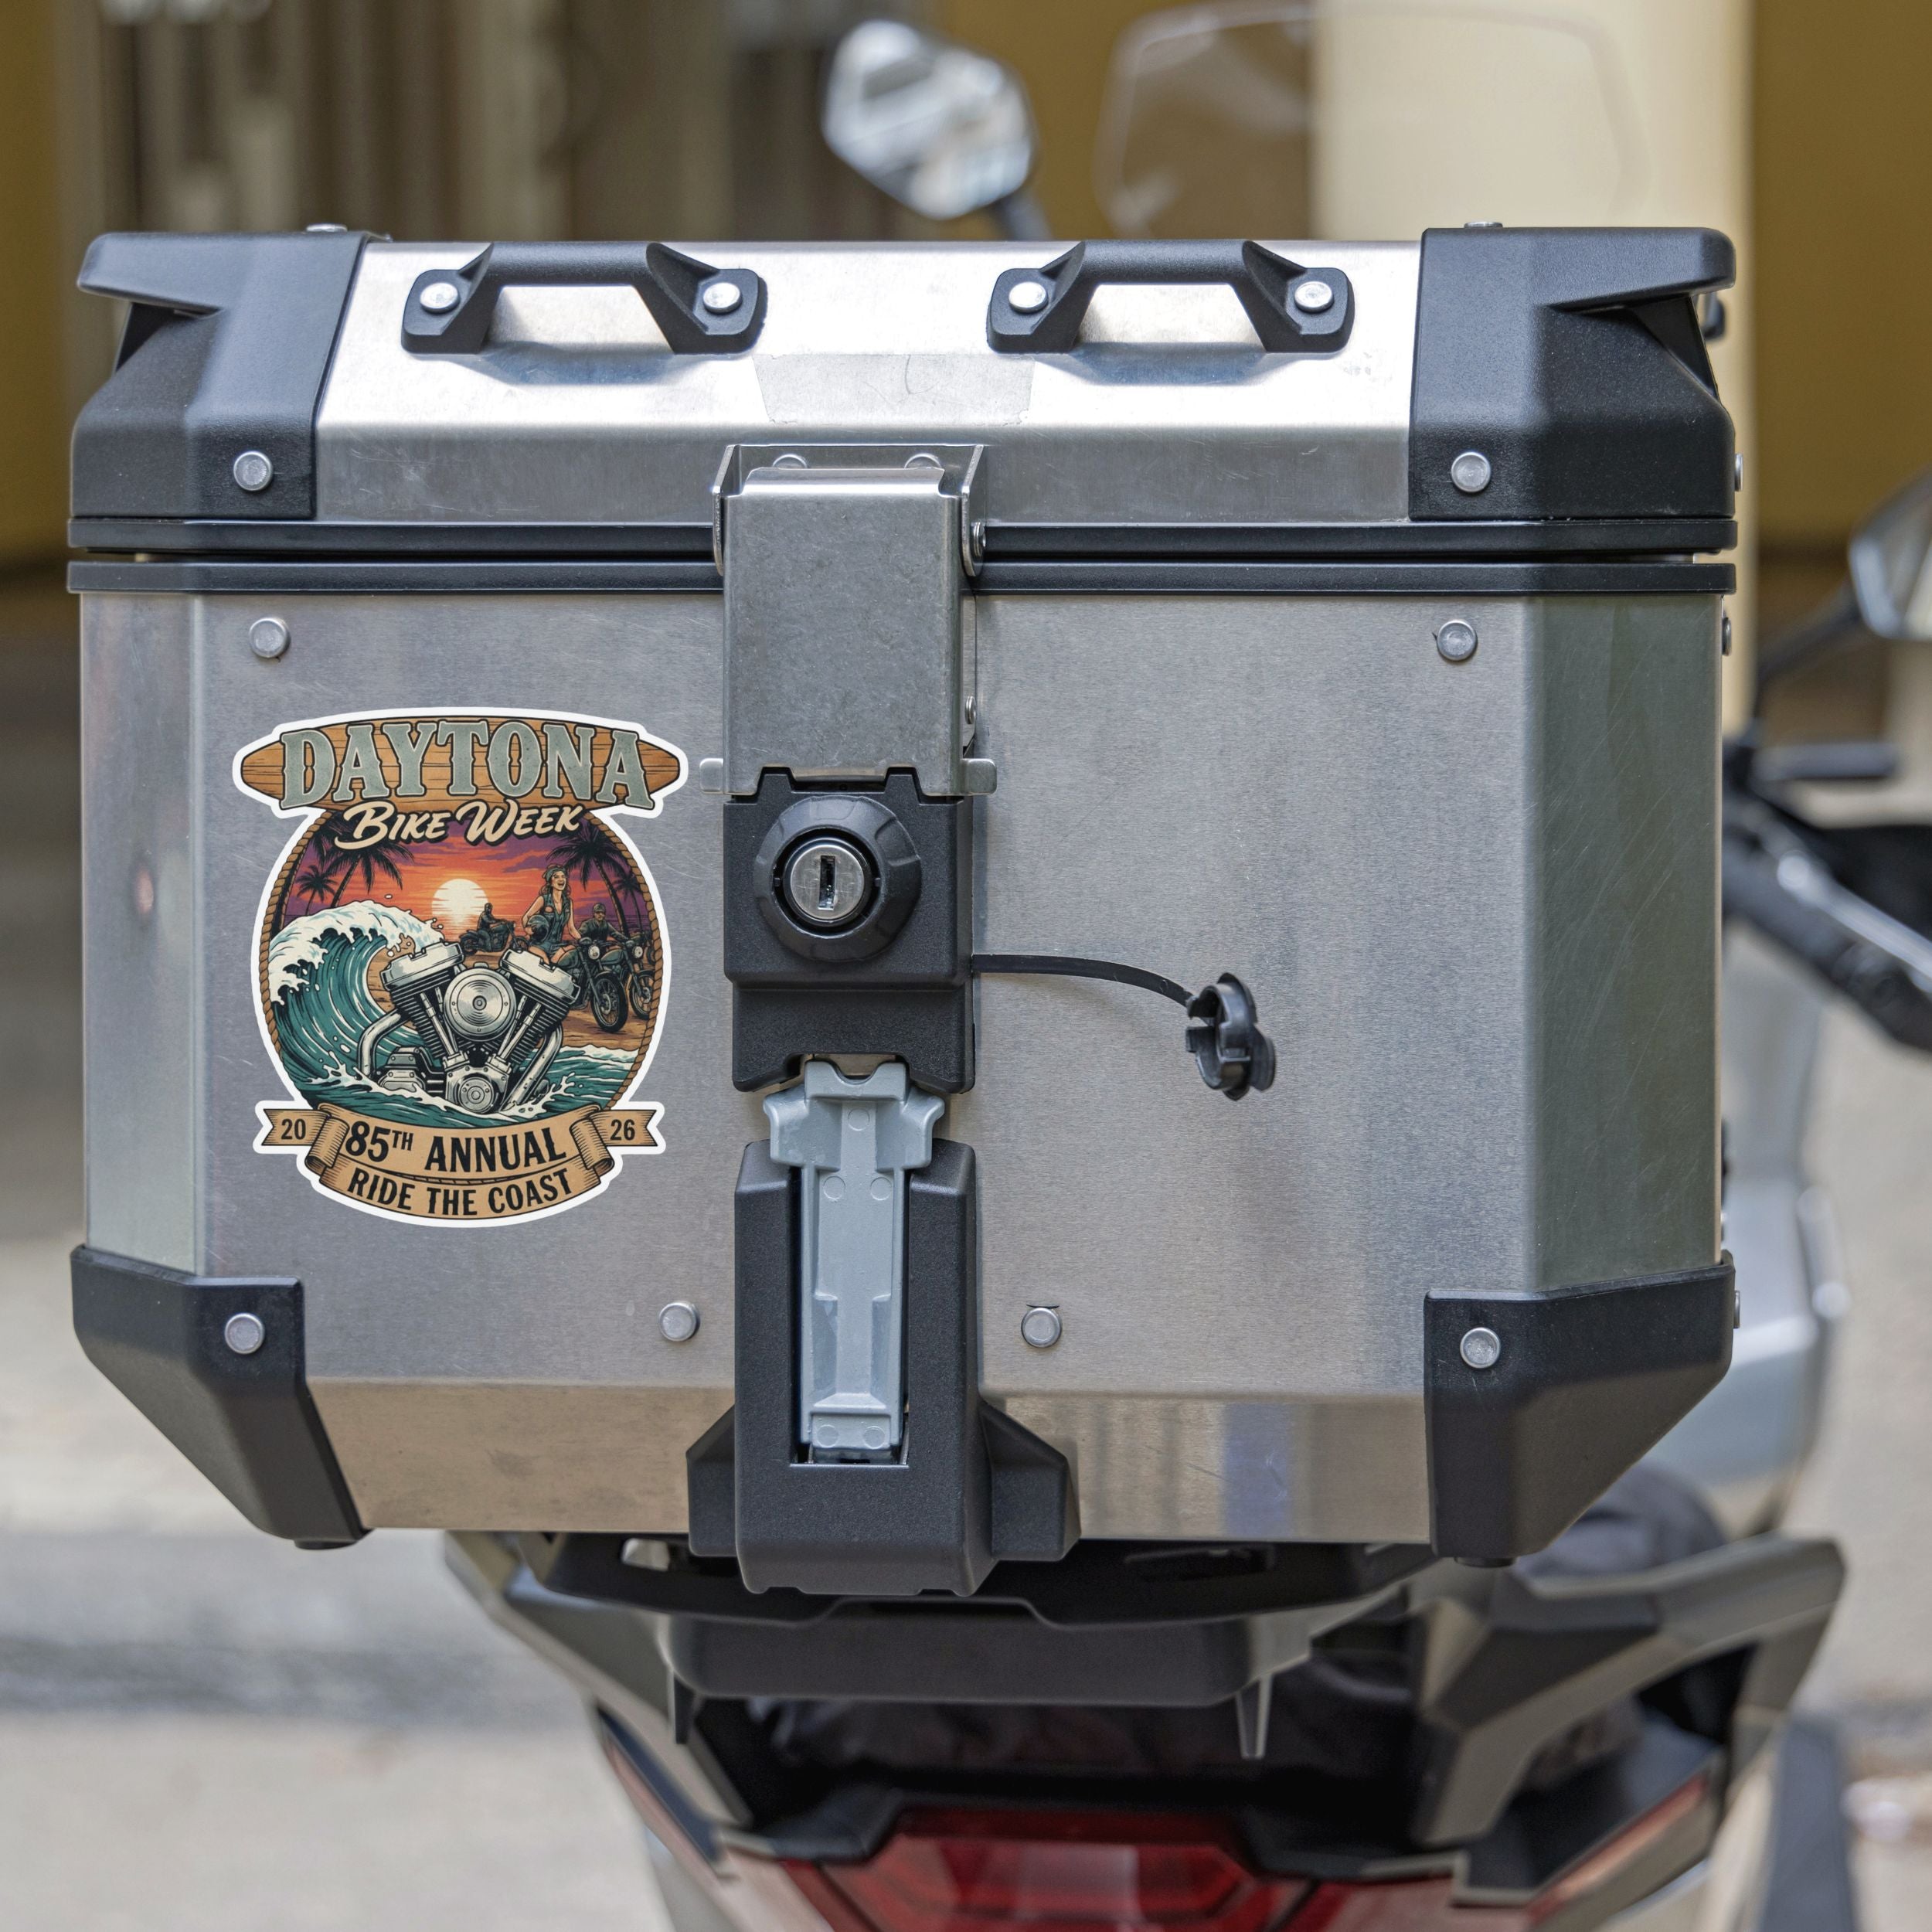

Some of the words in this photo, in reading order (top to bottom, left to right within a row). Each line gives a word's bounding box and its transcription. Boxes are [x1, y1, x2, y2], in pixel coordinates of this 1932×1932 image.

[279, 719, 655, 810] DAYTONA
[281, 1118, 307, 1140] 20
[345, 1121, 413, 1162] 85TH
[424, 1128, 566, 1172] ANNUAL
[610, 1118, 635, 1141] 26
[348, 1167, 416, 1211] RIDE
[427, 1188, 477, 1216] THE
[488, 1168, 573, 1211] COAST
